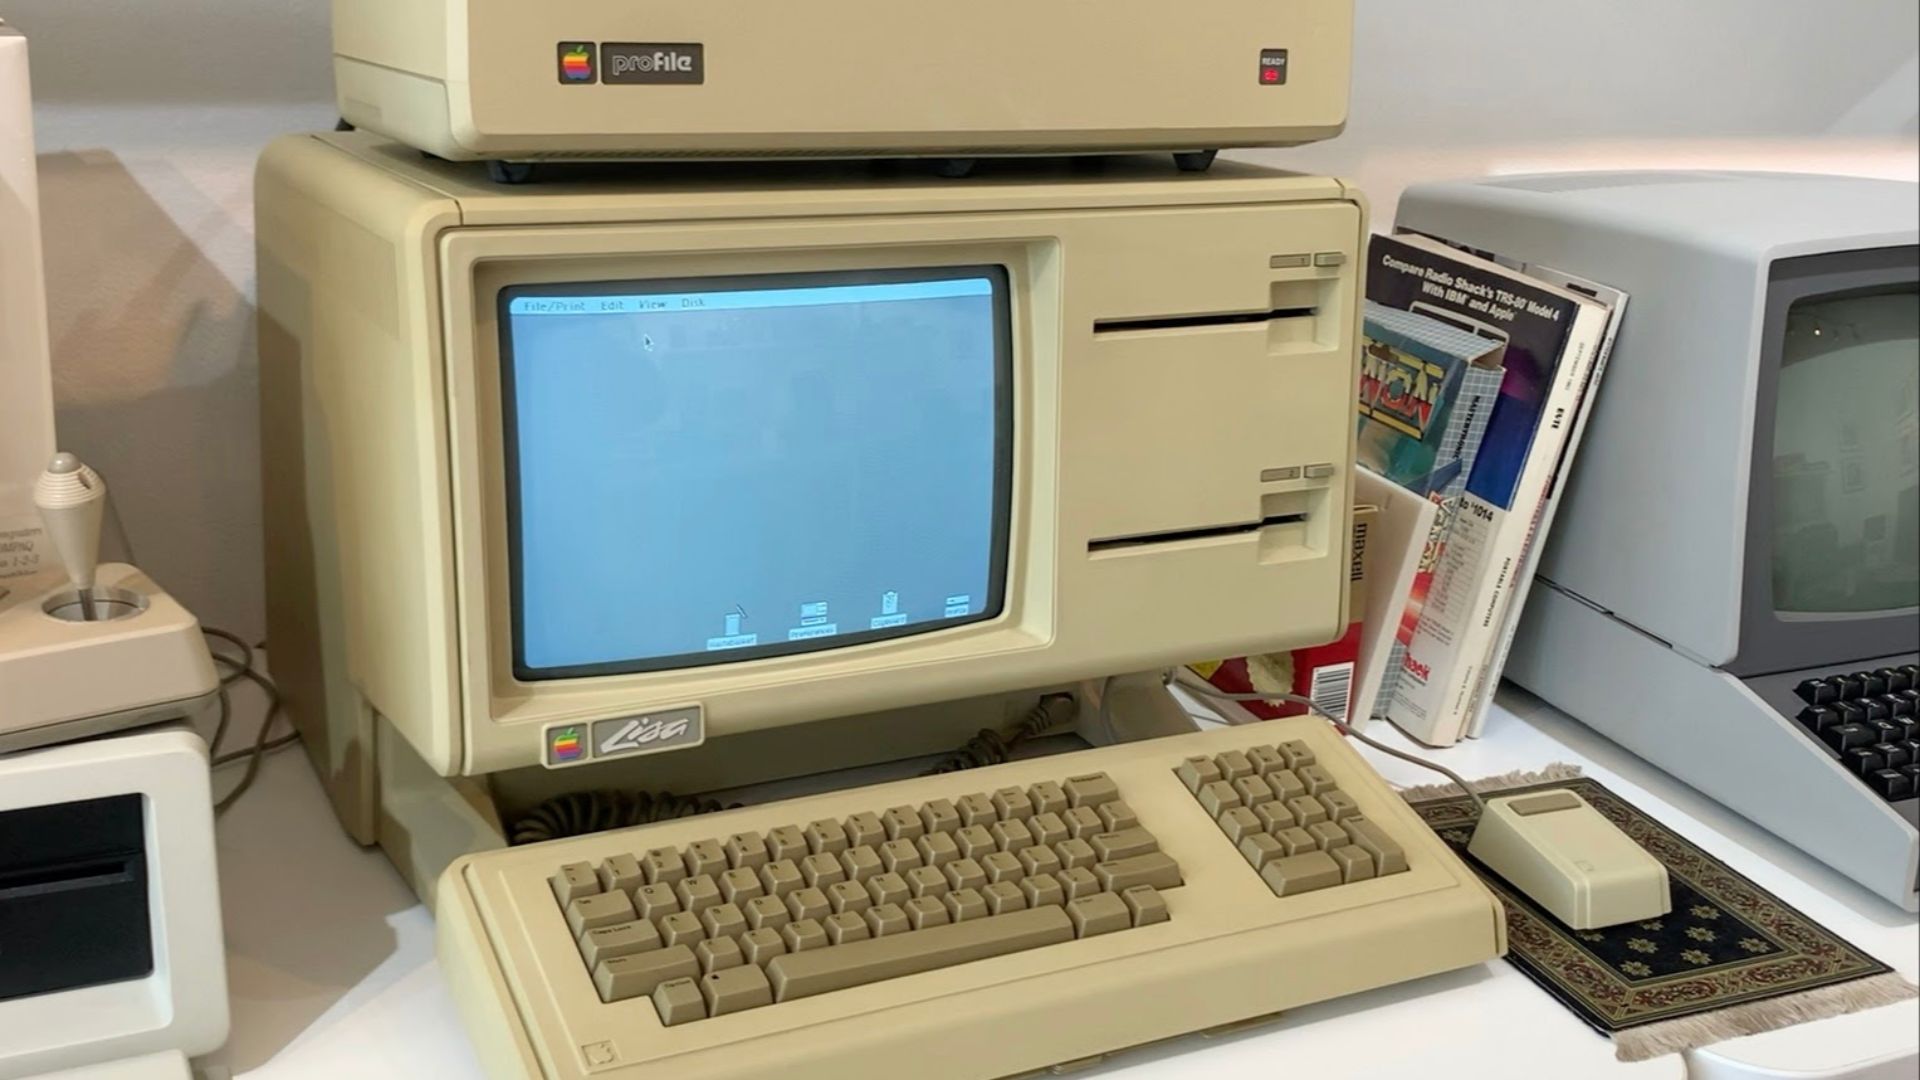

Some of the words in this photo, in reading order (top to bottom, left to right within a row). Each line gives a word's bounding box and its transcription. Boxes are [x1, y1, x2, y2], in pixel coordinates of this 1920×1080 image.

[600, 301, 624, 311] Edit
[639, 300, 668, 309] View
[681, 297, 706, 308] Disk
[1382, 254, 1425, 277] Compare
[1424, 267, 1454, 286] Radio
[1455, 276, 1494, 300] Shack's
[1526, 299, 1553, 319] Model
[1553, 309, 1560, 321] 4
[1421, 280, 1444, 299] With
[1468, 297, 1489, 313] and
[1459, 497, 1469, 510] to
[1351, 523, 1368, 581] maxell
[1496, 557, 1511, 588] PORTABLE
[1483, 590, 1500, 627] COMPUTERS
[1403, 651, 1431, 681] hack
[601, 717, 689, 753] Lisa
